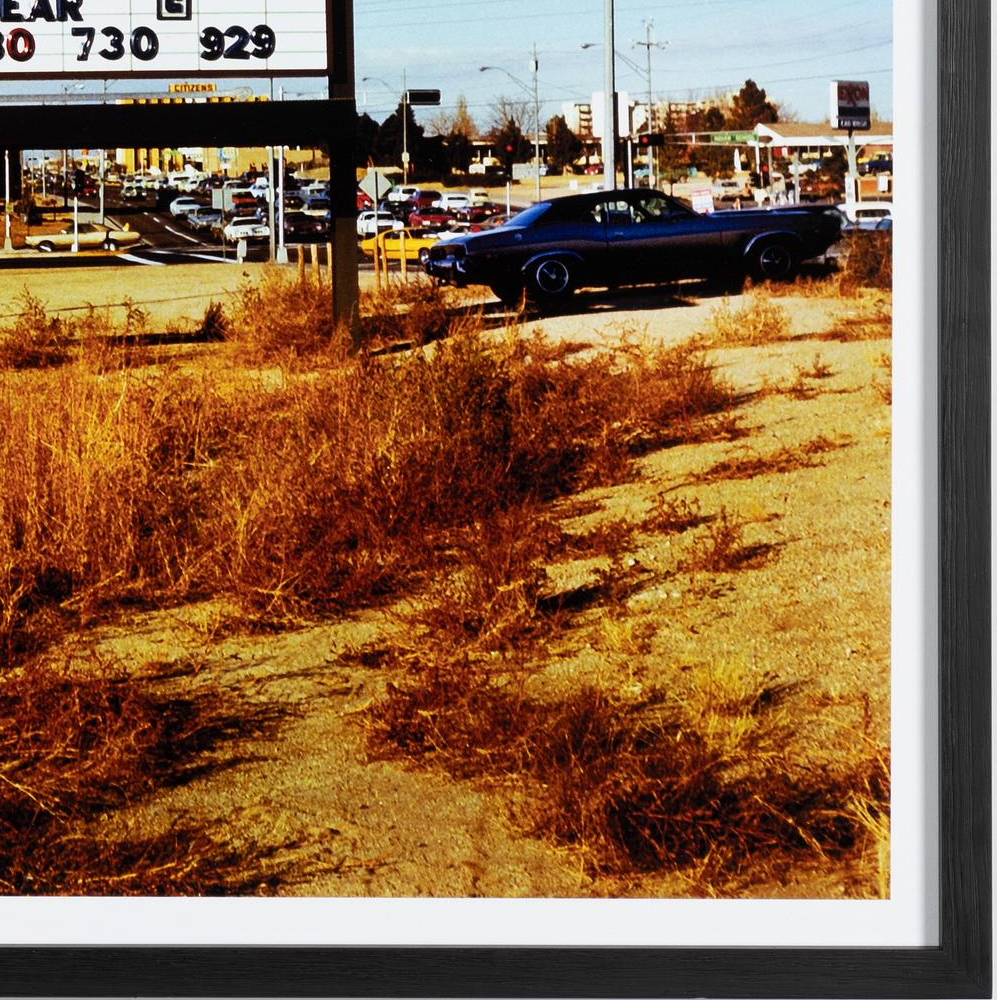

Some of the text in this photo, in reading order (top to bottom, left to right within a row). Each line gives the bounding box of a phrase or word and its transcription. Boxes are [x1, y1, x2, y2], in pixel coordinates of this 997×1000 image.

[71, 25, 160, 62] 730
[200, 24, 276, 61] 929
[174, 84, 213, 92] CITIZENS
